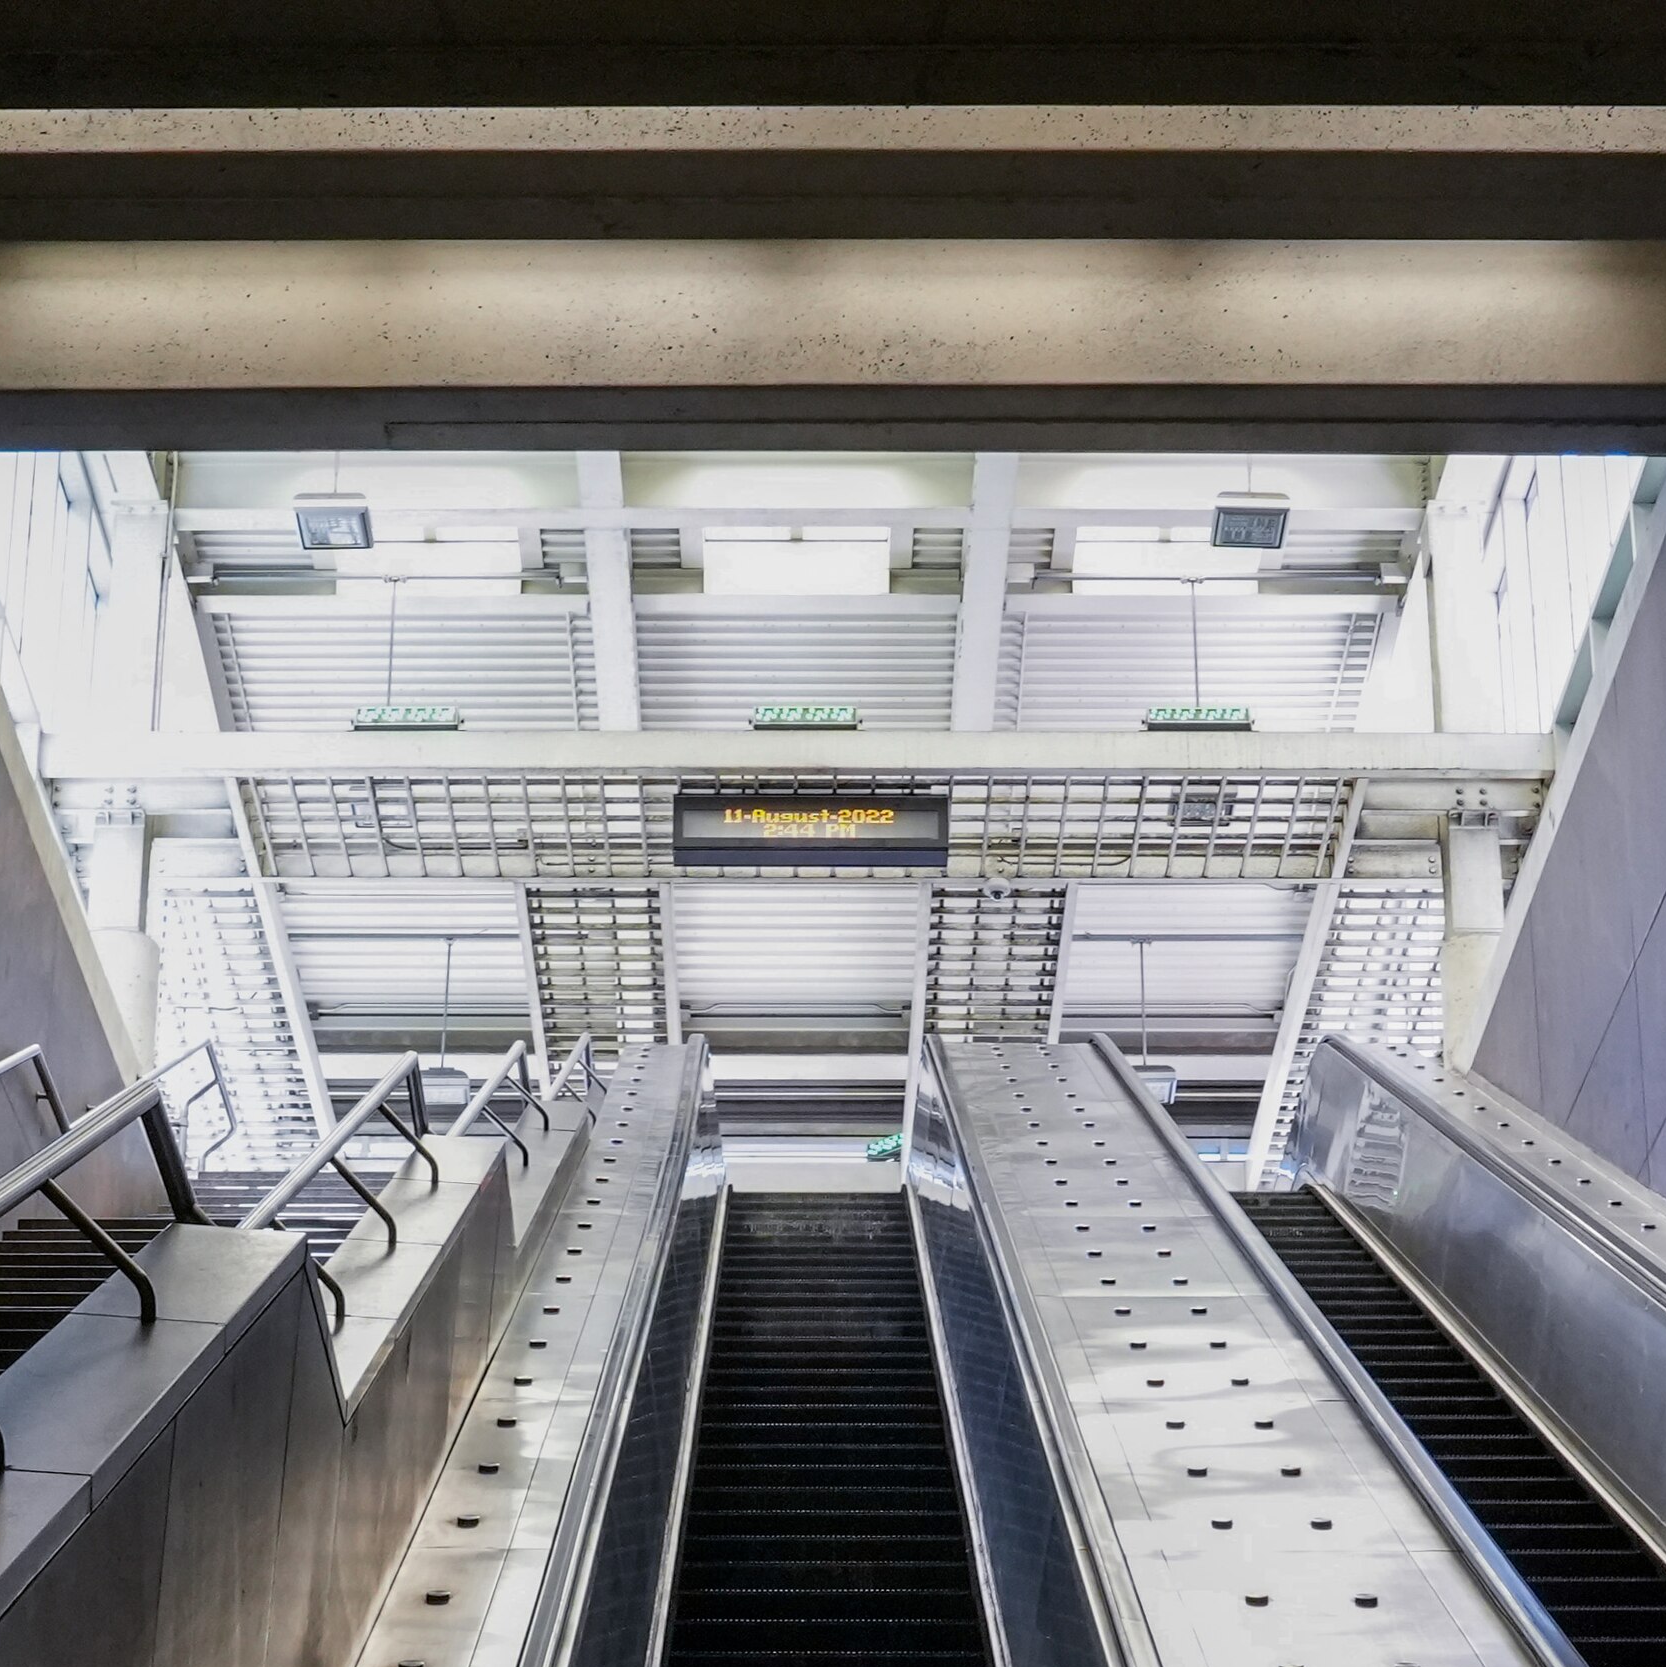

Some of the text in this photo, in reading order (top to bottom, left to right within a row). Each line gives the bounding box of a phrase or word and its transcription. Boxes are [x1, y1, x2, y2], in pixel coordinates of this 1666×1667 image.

[724, 809, 894, 823] 11-August-2022
[763, 824, 856, 837] 2:44 PM
